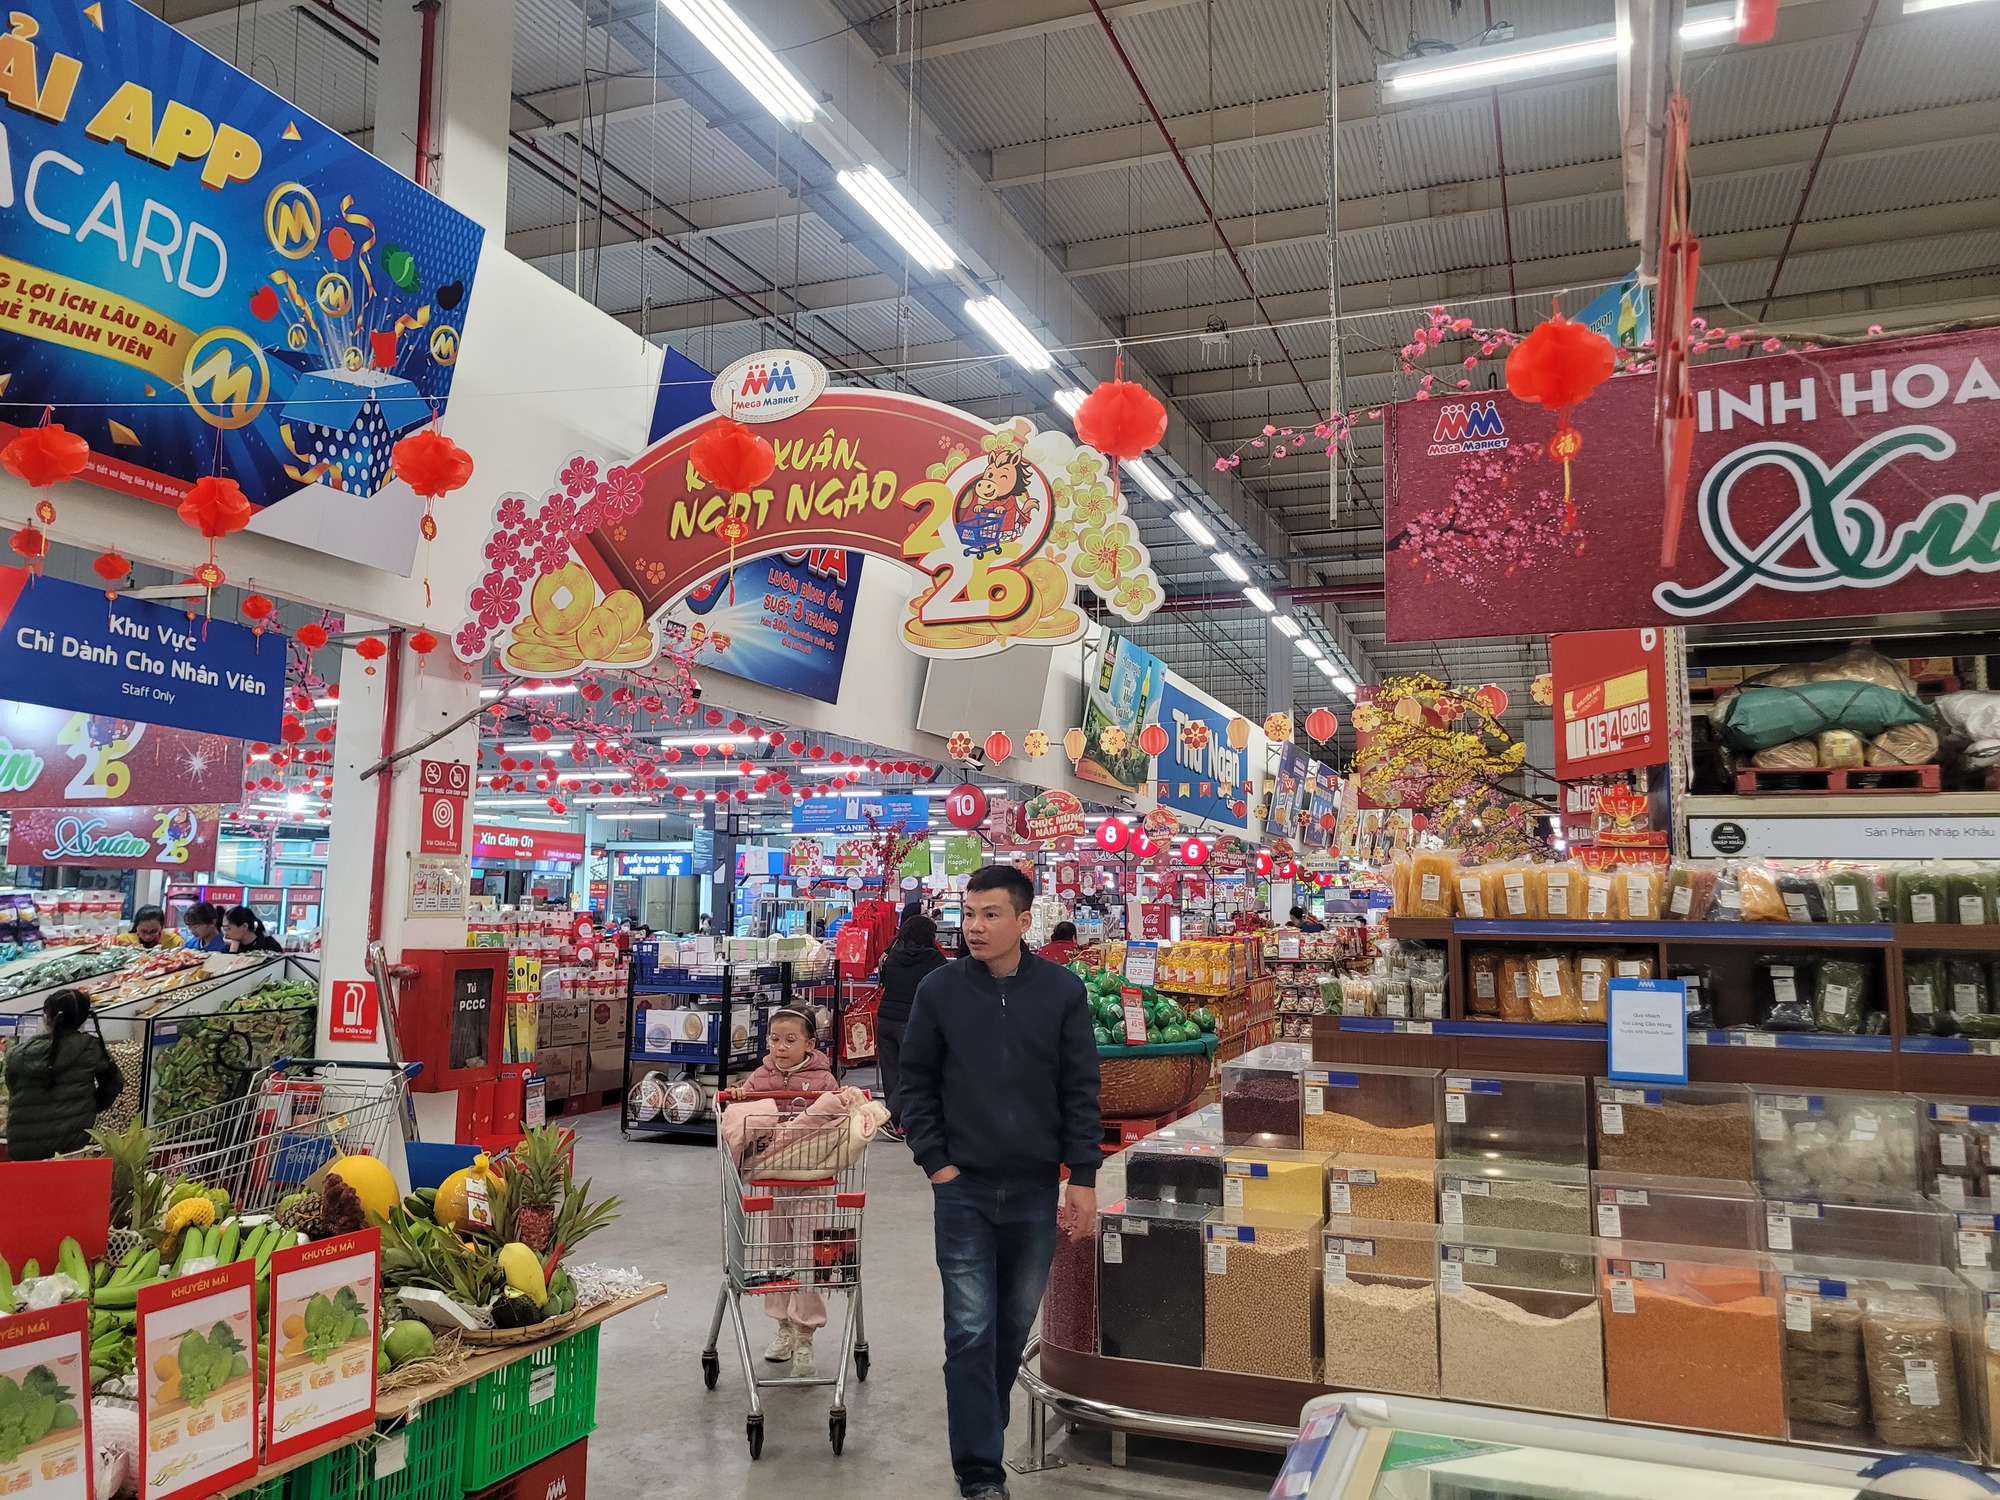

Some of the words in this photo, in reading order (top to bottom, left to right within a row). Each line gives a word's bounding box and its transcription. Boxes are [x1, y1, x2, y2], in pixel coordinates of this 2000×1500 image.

[85, 81, 262, 189] APP
[16, 278, 56, 303] LỢI
[58, 287, 97, 315] ÍCH
[100, 304, 140, 329] LÂU
[142, 321, 177, 347] DÀI
[28, 308, 102, 342] THÀNH
[108, 332, 153, 360] VIÊN
[774, 428, 861, 473] XUÂN
[786, 460, 897, 523] NGÀO
[768, 568, 799, 594] LUÔN
[800, 581, 825, 606] BÌNH
[764, 593, 791, 618] SUỐT
[792, 600, 804, 621] 3
[805, 611, 839, 635] THÁNG
[772, 617, 789, 633] 300
[109, 613, 149, 641] Khu
[157, 625, 197, 652] Vực
[17, 627, 54, 653] Chỉ
[61, 636, 117, 666] Dành
[125, 650, 164, 675] Cho
[171, 660, 219, 687] Nhân
[226, 671, 266, 695] Viên
[122, 683, 149, 698] Staff
[152, 689, 175, 705] Only
[954, 795, 975, 817] 10
[1030, 818, 1053, 829] CHÚC
[1056, 813, 1085, 825] MỪNG
[1035, 826, 1057, 838] NĂM
[43, 816, 150, 860] Xuân
[480, 832, 496, 846] Xin
[1105, 825, 1116, 843] 8
[1140, 834, 1150, 850] 7
[948, 858, 972, 866] Happily!
[1187, 844, 1198, 859] 6
[459, 999, 486, 1011] PCCC
[301, 1245, 340, 1262] KHUYẾN
[341, 1240, 356, 1252] MÃI
[171, 1278, 210, 1299] KHUYẾN
[212, 1272, 229, 1288] MÃI
[27, 1320, 50, 1336] MÃI
